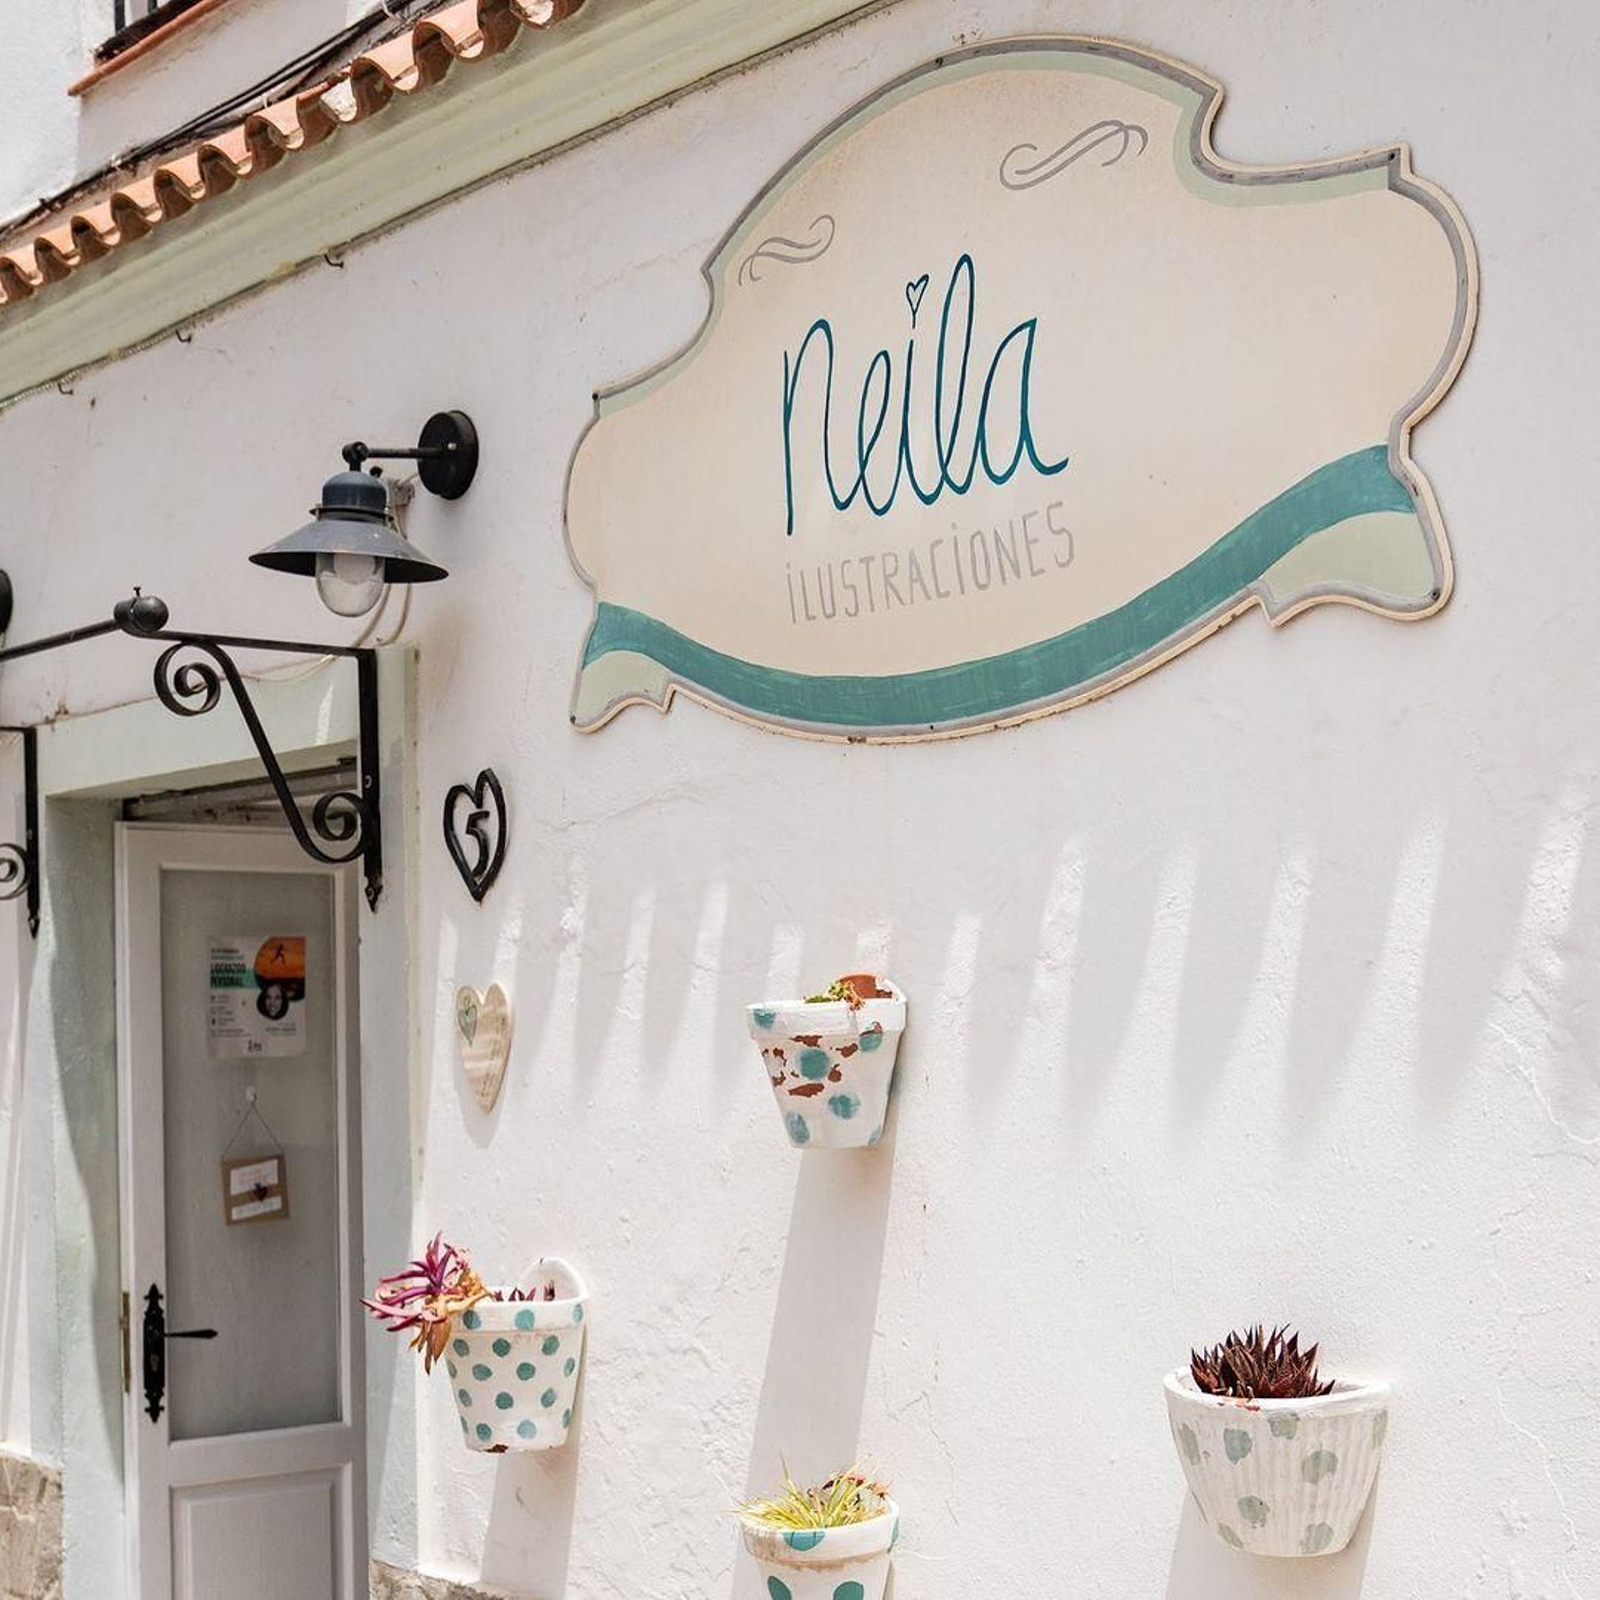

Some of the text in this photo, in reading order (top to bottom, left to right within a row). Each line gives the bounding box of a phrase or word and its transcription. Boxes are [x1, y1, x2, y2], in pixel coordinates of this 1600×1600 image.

[783, 253, 1069, 536] neila
[465, 810, 490, 878] 5
[210, 975, 244, 989] PERSONAL
